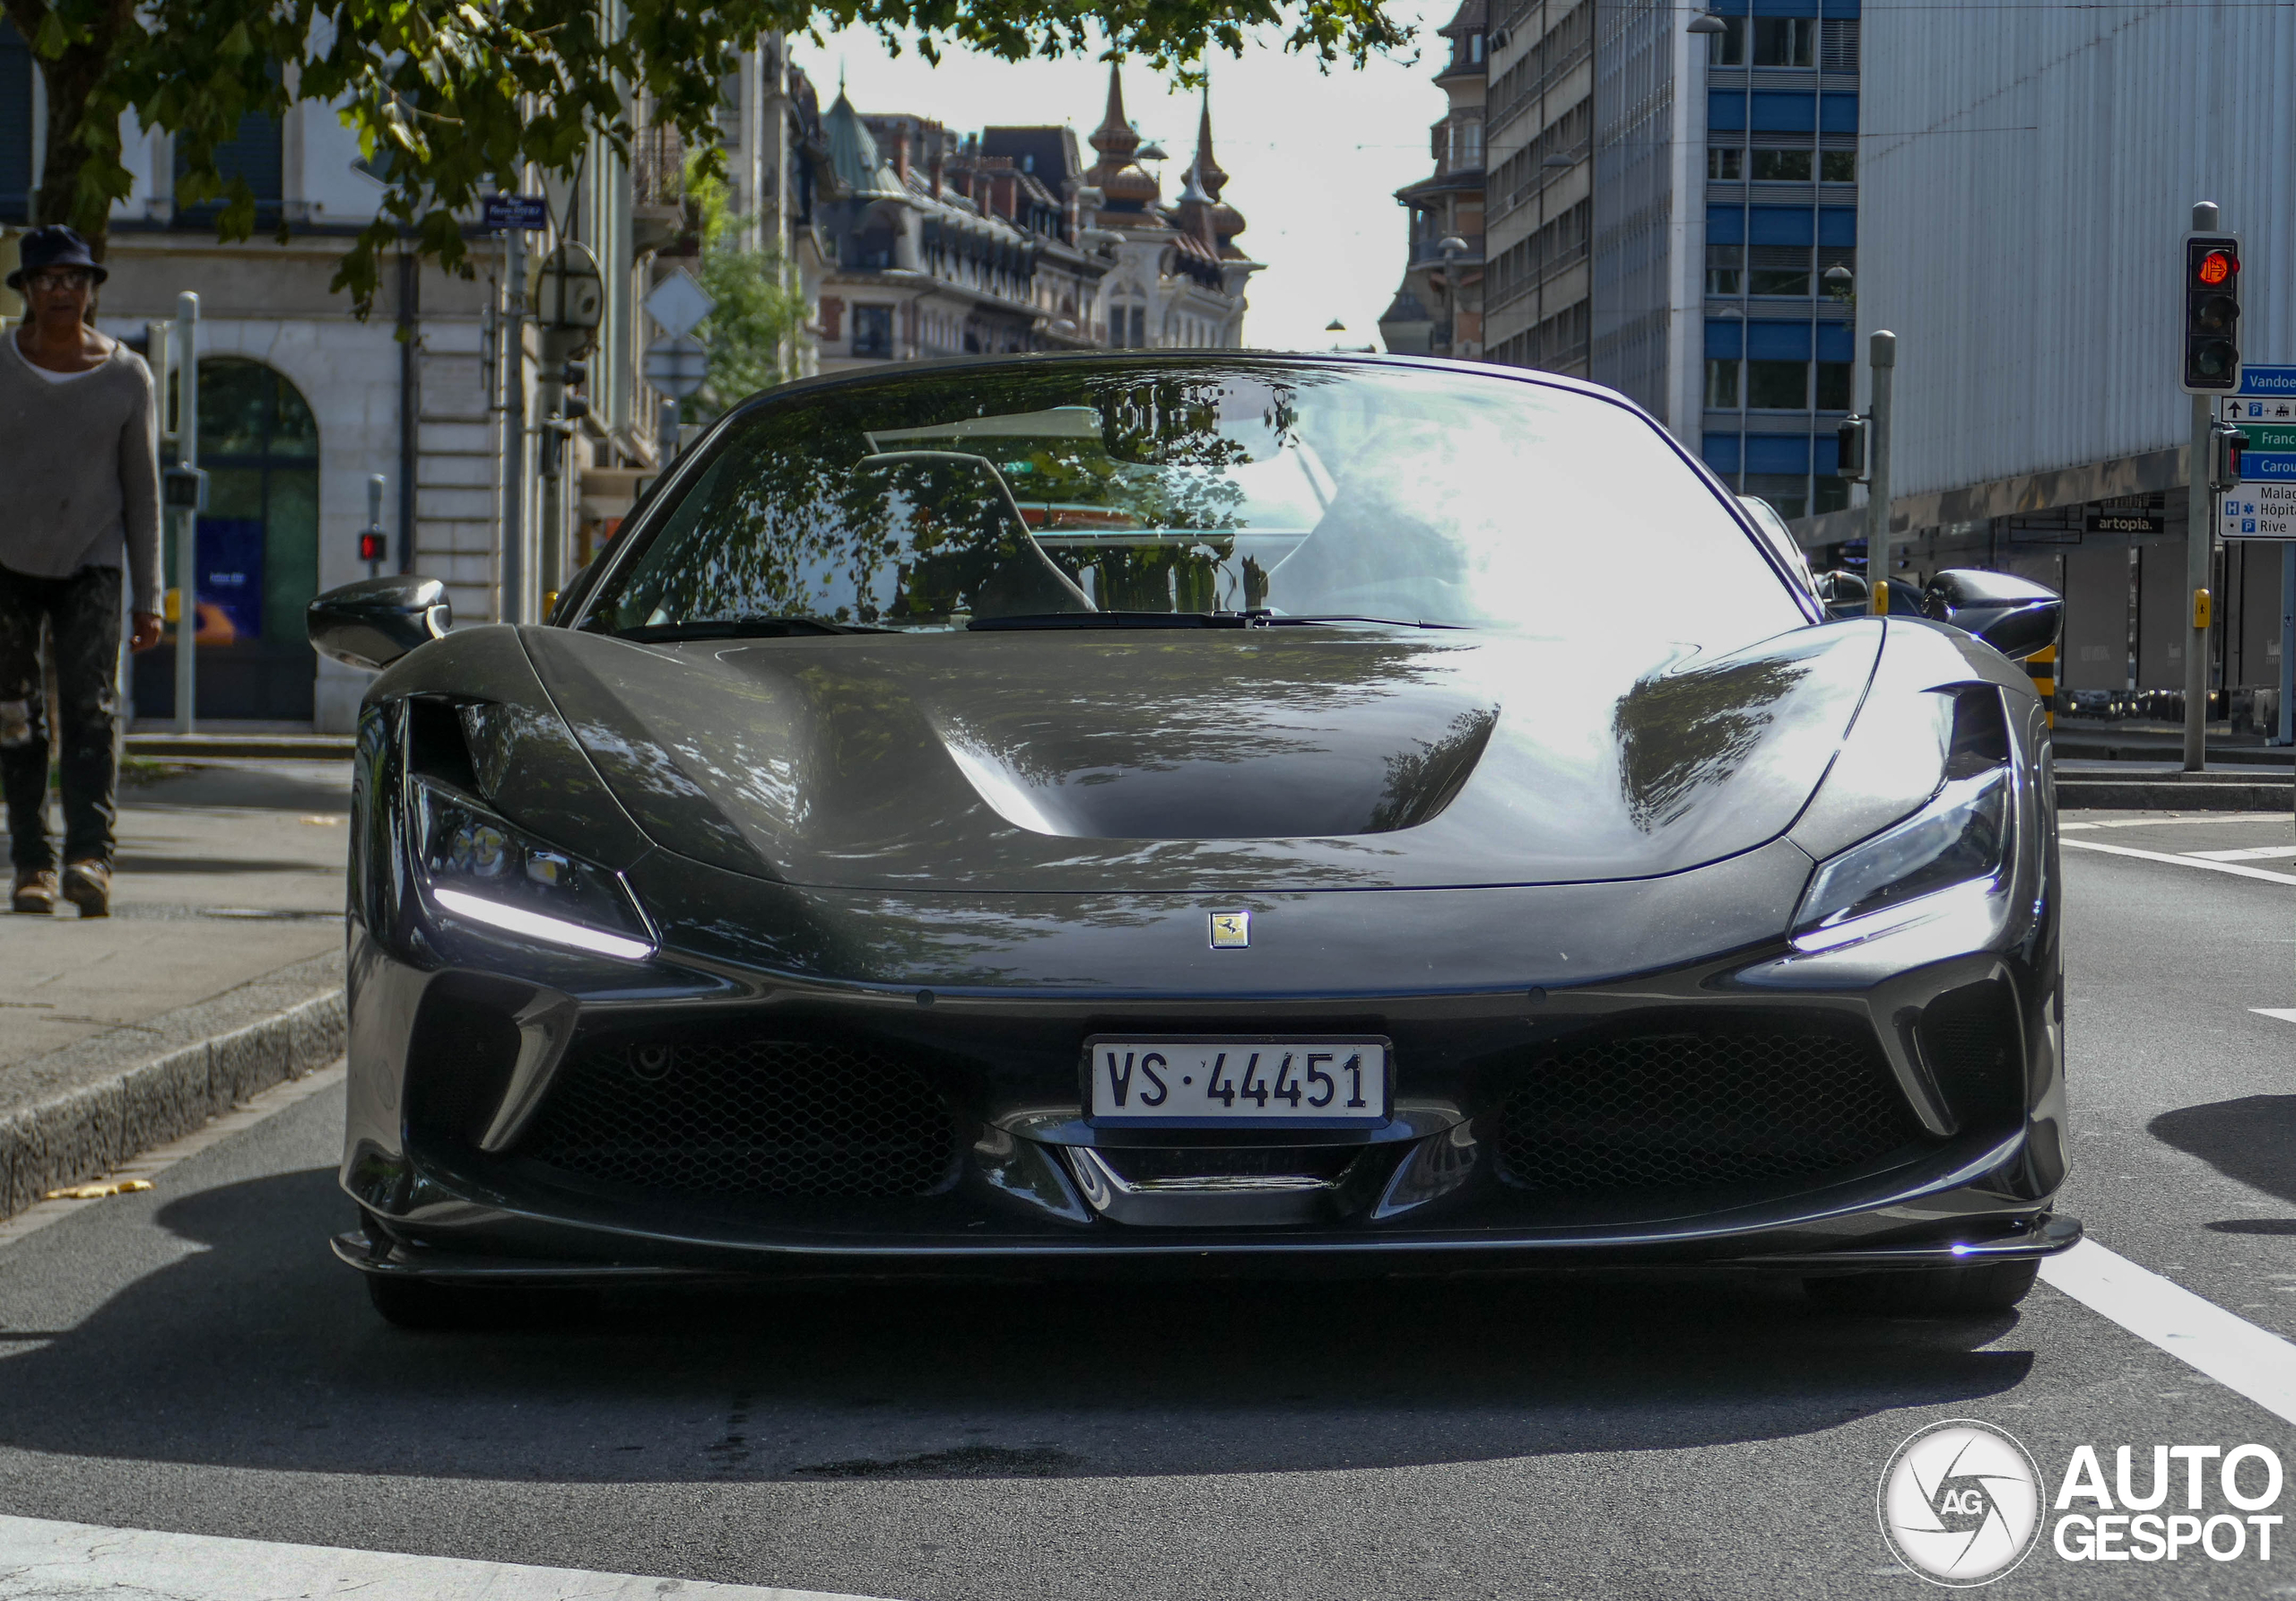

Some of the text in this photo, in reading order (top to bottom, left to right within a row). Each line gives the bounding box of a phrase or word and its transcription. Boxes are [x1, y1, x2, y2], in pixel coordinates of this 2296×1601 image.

[2249, 375, 2296, 387] Vandoe
[2262, 431, 2296, 445] Franc
[2261, 460, 2296, 473] Carou
[2260, 503, 2296, 518] Hôpit
[2099, 518, 2152, 532] artopia.
[2260, 520, 2287, 533] Rive
